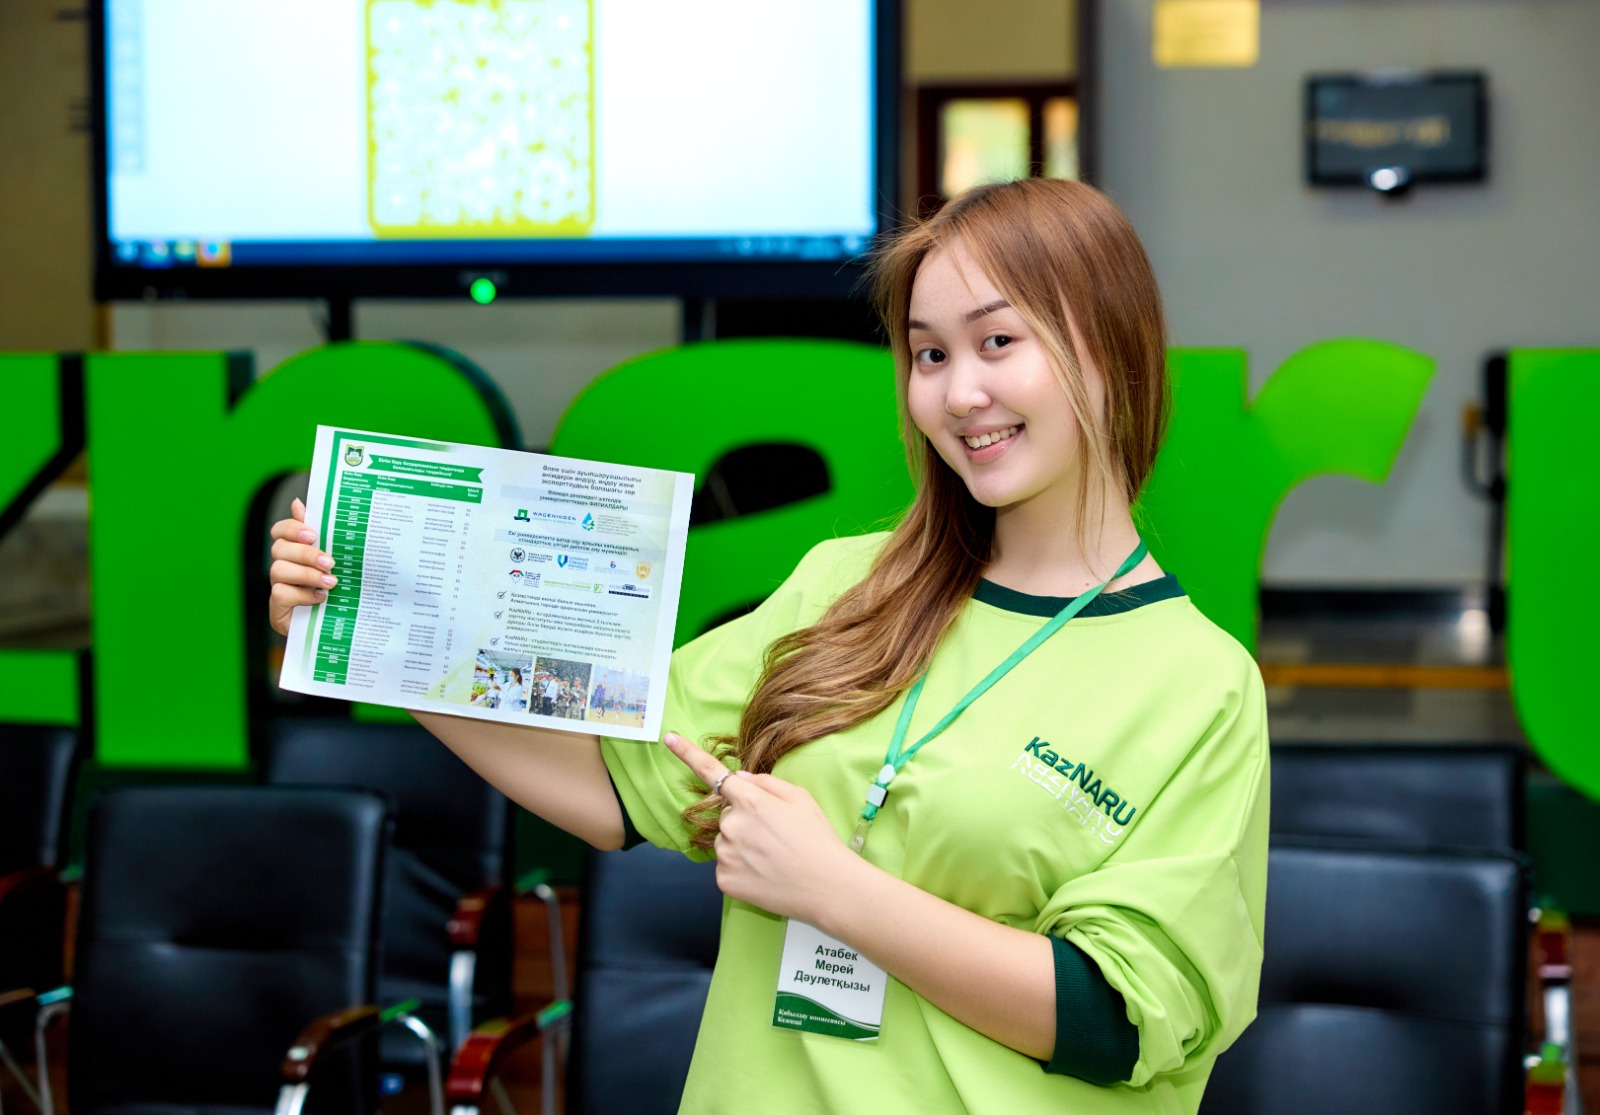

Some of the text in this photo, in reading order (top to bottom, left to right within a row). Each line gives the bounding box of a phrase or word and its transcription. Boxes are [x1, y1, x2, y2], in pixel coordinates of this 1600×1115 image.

[532, 511, 576, 521] WAGENINGEN
[1024, 736, 1137, 827] KazNARU
[815, 944, 858, 961] Атабек
[815, 959, 854, 975] Мерей
[793, 970, 871, 992] Дәулетқызы
